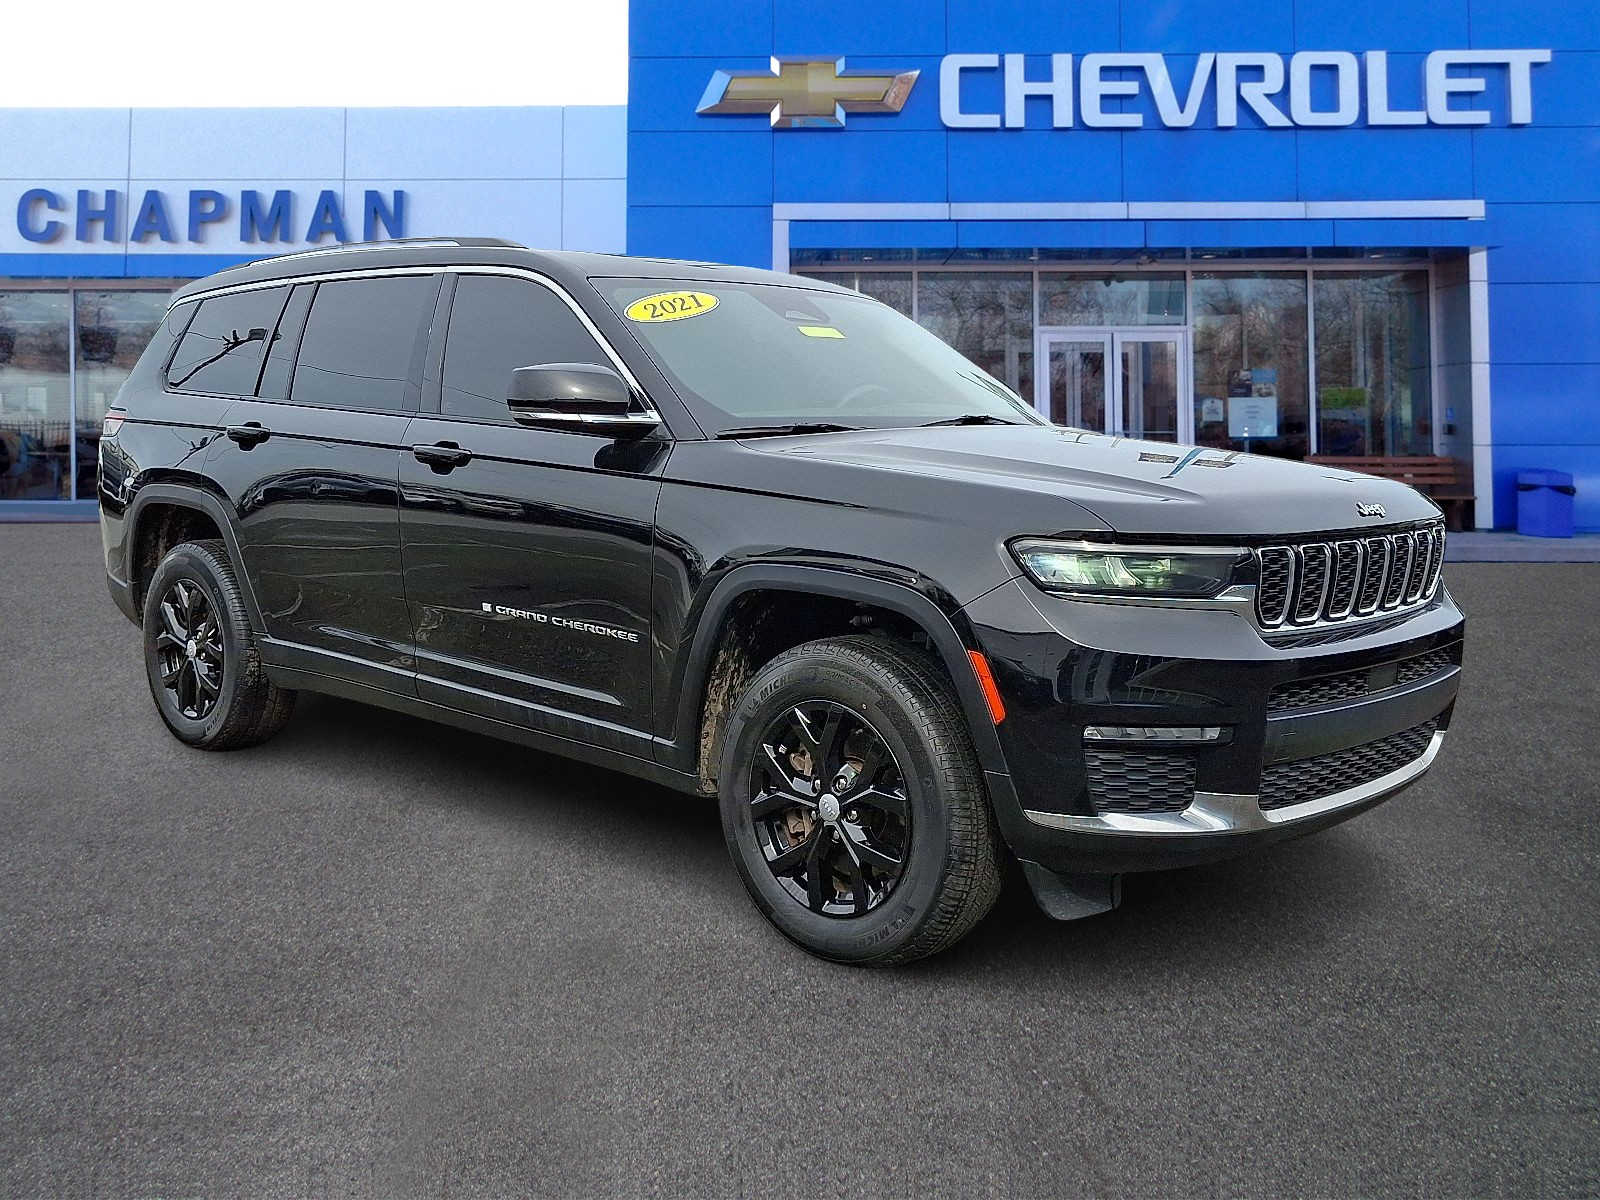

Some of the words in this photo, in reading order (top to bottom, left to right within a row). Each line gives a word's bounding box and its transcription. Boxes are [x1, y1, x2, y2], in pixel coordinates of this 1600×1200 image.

[940, 49, 1552, 128] CHEVROLET
[16, 188, 409, 243] CHAPMAN
[643, 293, 705, 320] 2021
[1355, 501, 1387, 518] Jeep
[495, 605, 548, 623] GRAND
[551, 616, 640, 643] CHEROKEE
